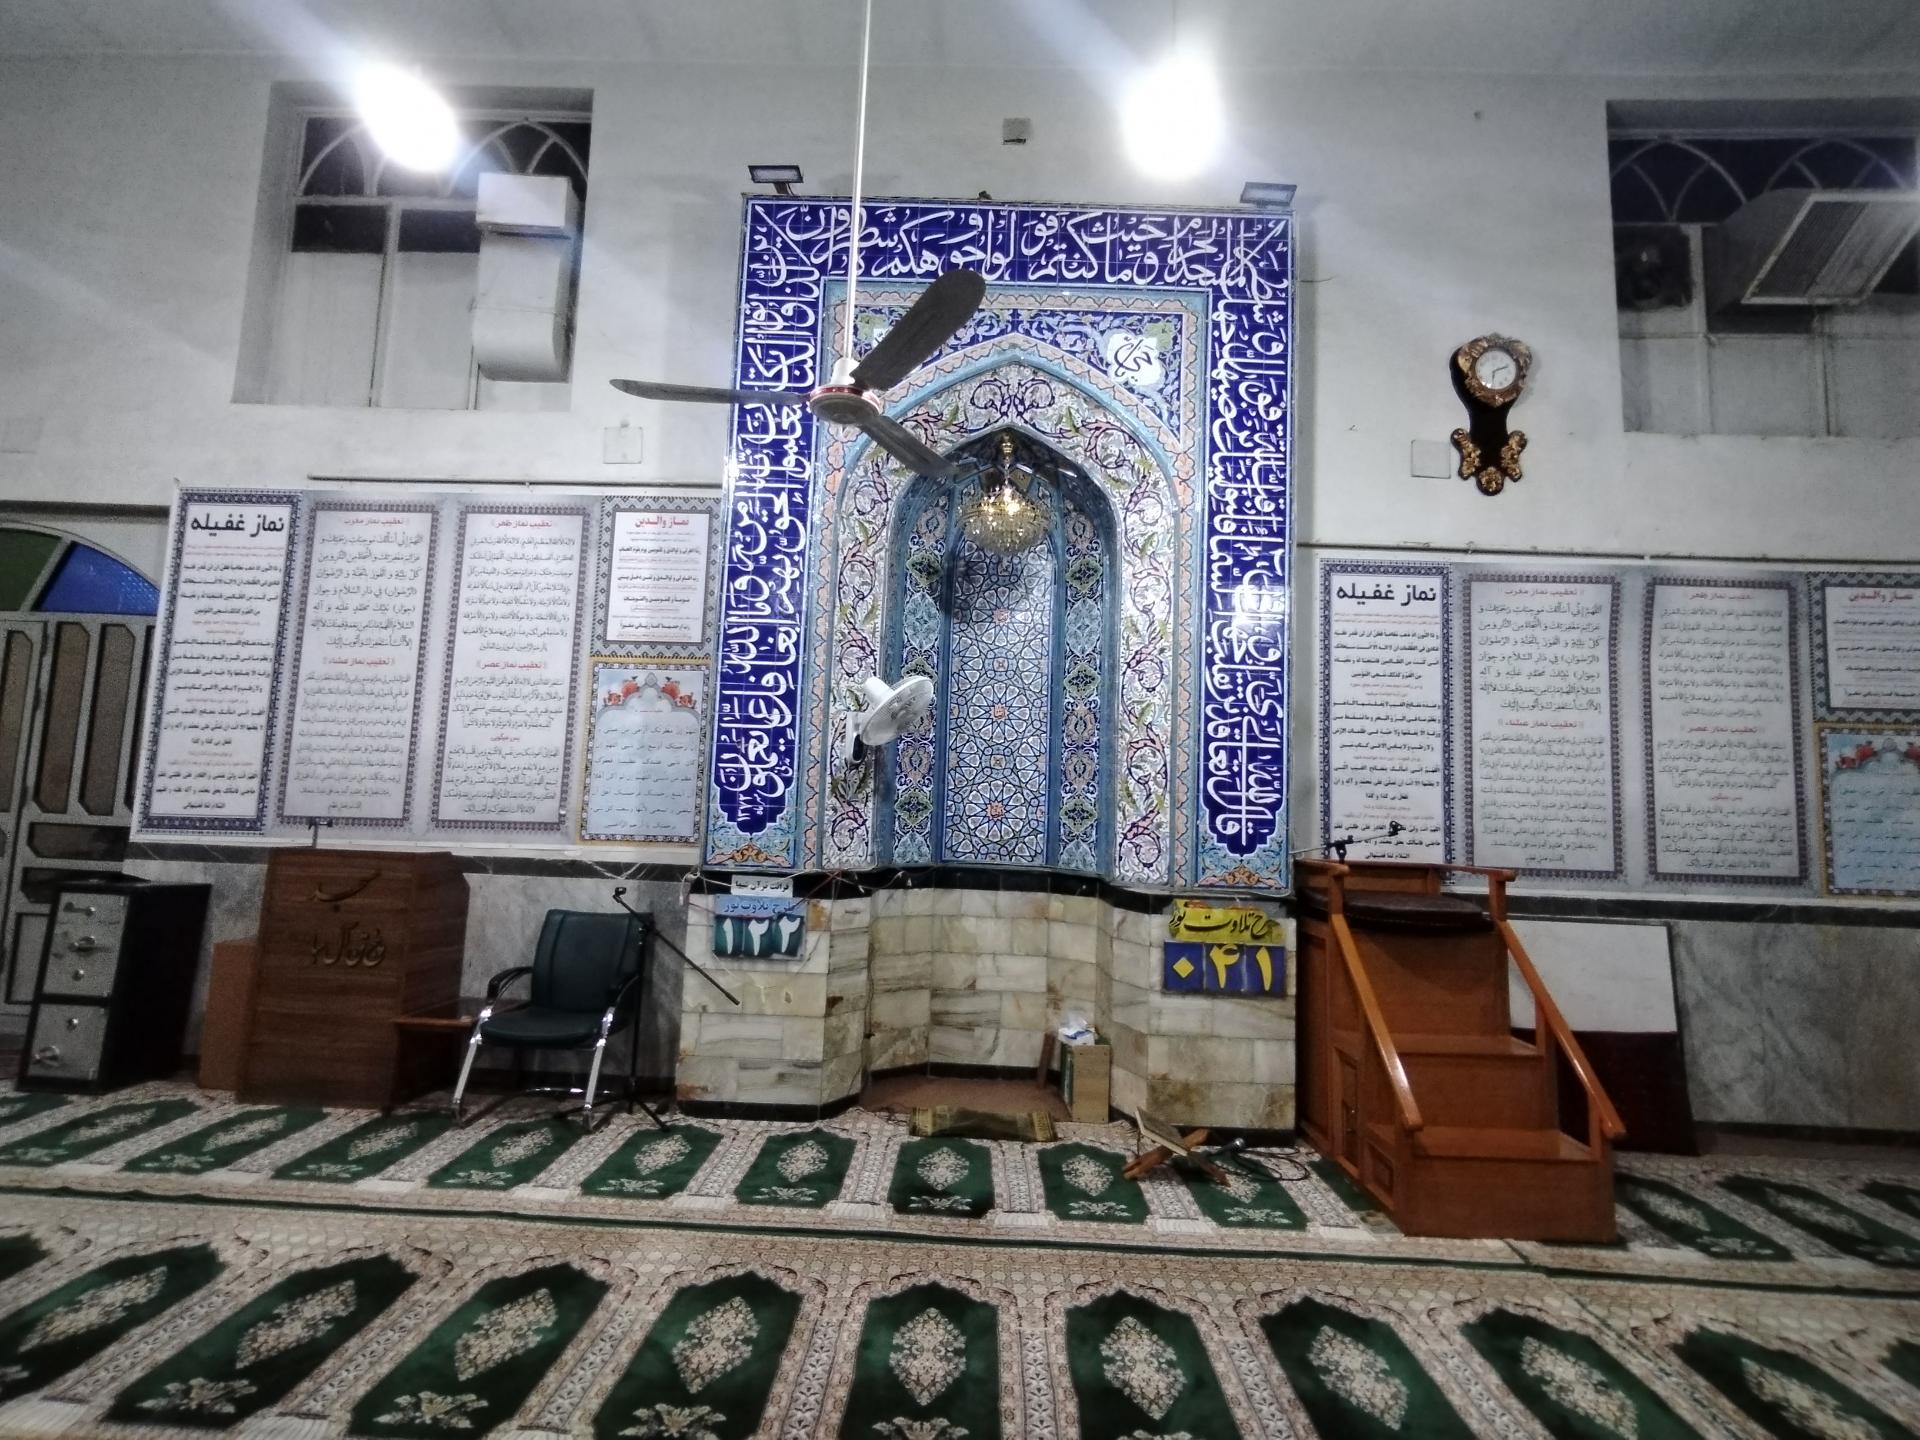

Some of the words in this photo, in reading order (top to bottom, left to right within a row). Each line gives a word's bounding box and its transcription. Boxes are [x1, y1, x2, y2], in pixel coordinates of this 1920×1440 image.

[191, 513, 245, 537] غفیله
[249, 514, 284, 538] نماز
[1336, 583, 1394, 605] غفیله
[1400, 584, 1436, 606] نماز
